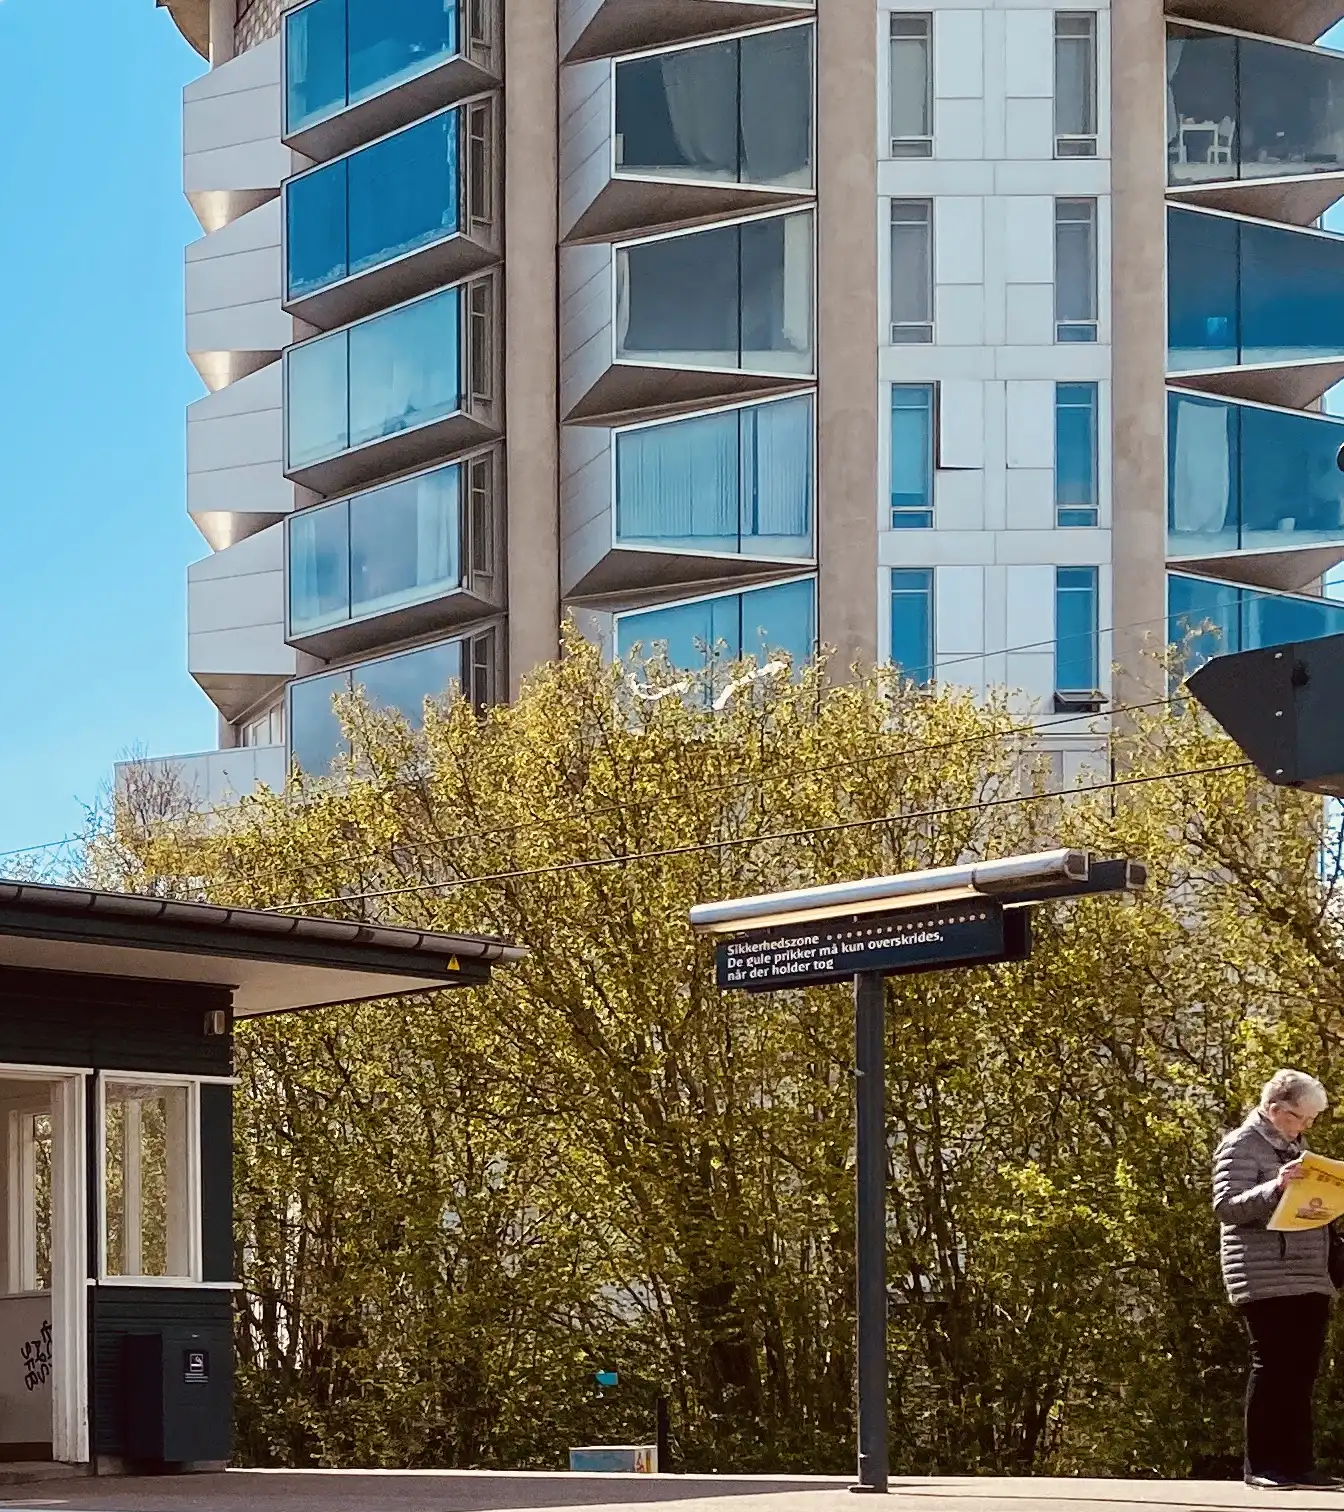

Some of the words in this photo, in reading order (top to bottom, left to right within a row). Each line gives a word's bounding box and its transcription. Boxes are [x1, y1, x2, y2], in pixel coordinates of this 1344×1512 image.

[727, 935, 820, 956] Sikkerhedszone
[727, 957, 744, 969] De
[746, 954, 772, 967] gule
[774, 947, 816, 964] prikker
[819, 944, 838, 957] må
[841, 939, 864, 953] kun
[727, 968, 747, 981] når
[749, 967, 769, 979] der
[771, 962, 812, 976] holder
[814, 958, 834, 970] tog
